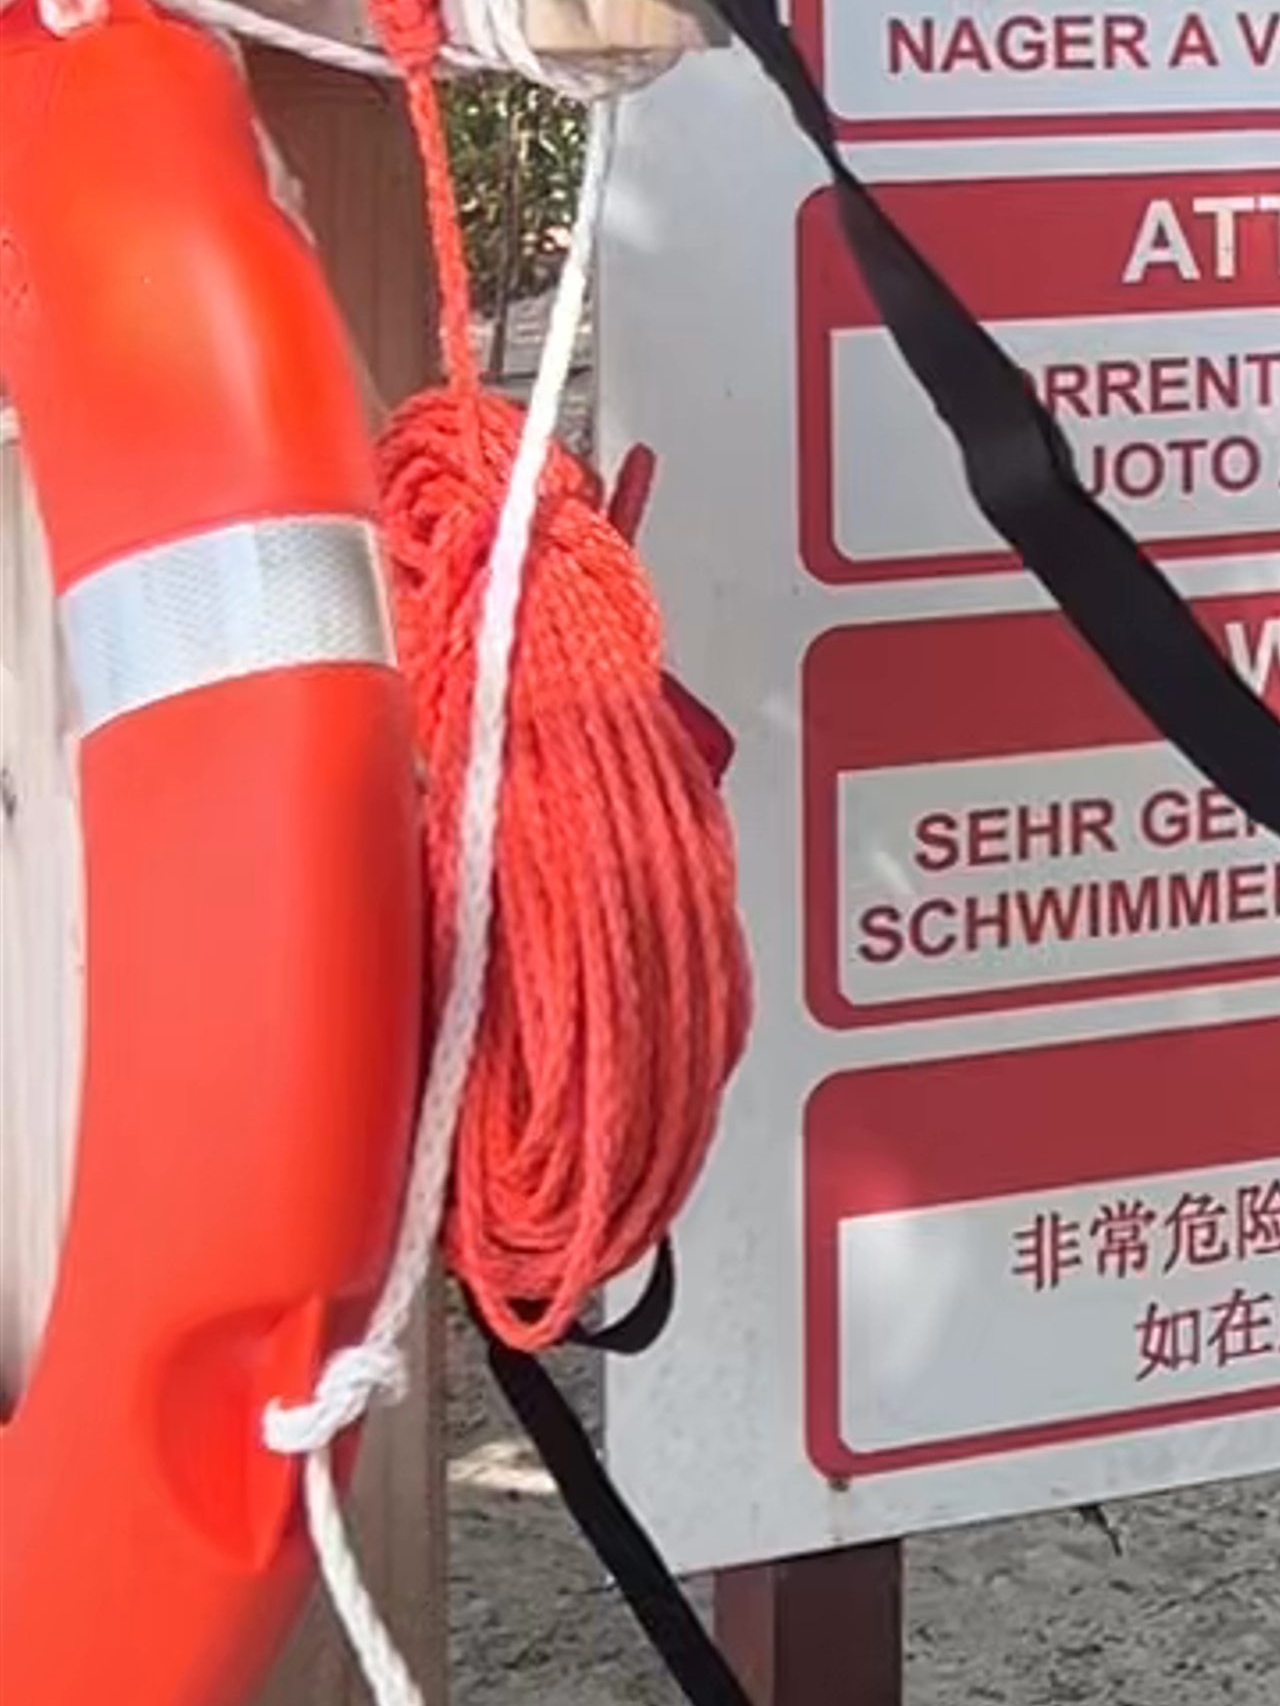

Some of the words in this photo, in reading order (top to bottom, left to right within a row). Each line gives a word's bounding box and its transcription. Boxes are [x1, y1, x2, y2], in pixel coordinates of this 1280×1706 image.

[887, 14, 1150, 75] NAGER
[1168, 12, 1220, 69] A
[1086, 434, 1262, 499] OTO
[913, 796, 1119, 874] SEHR
